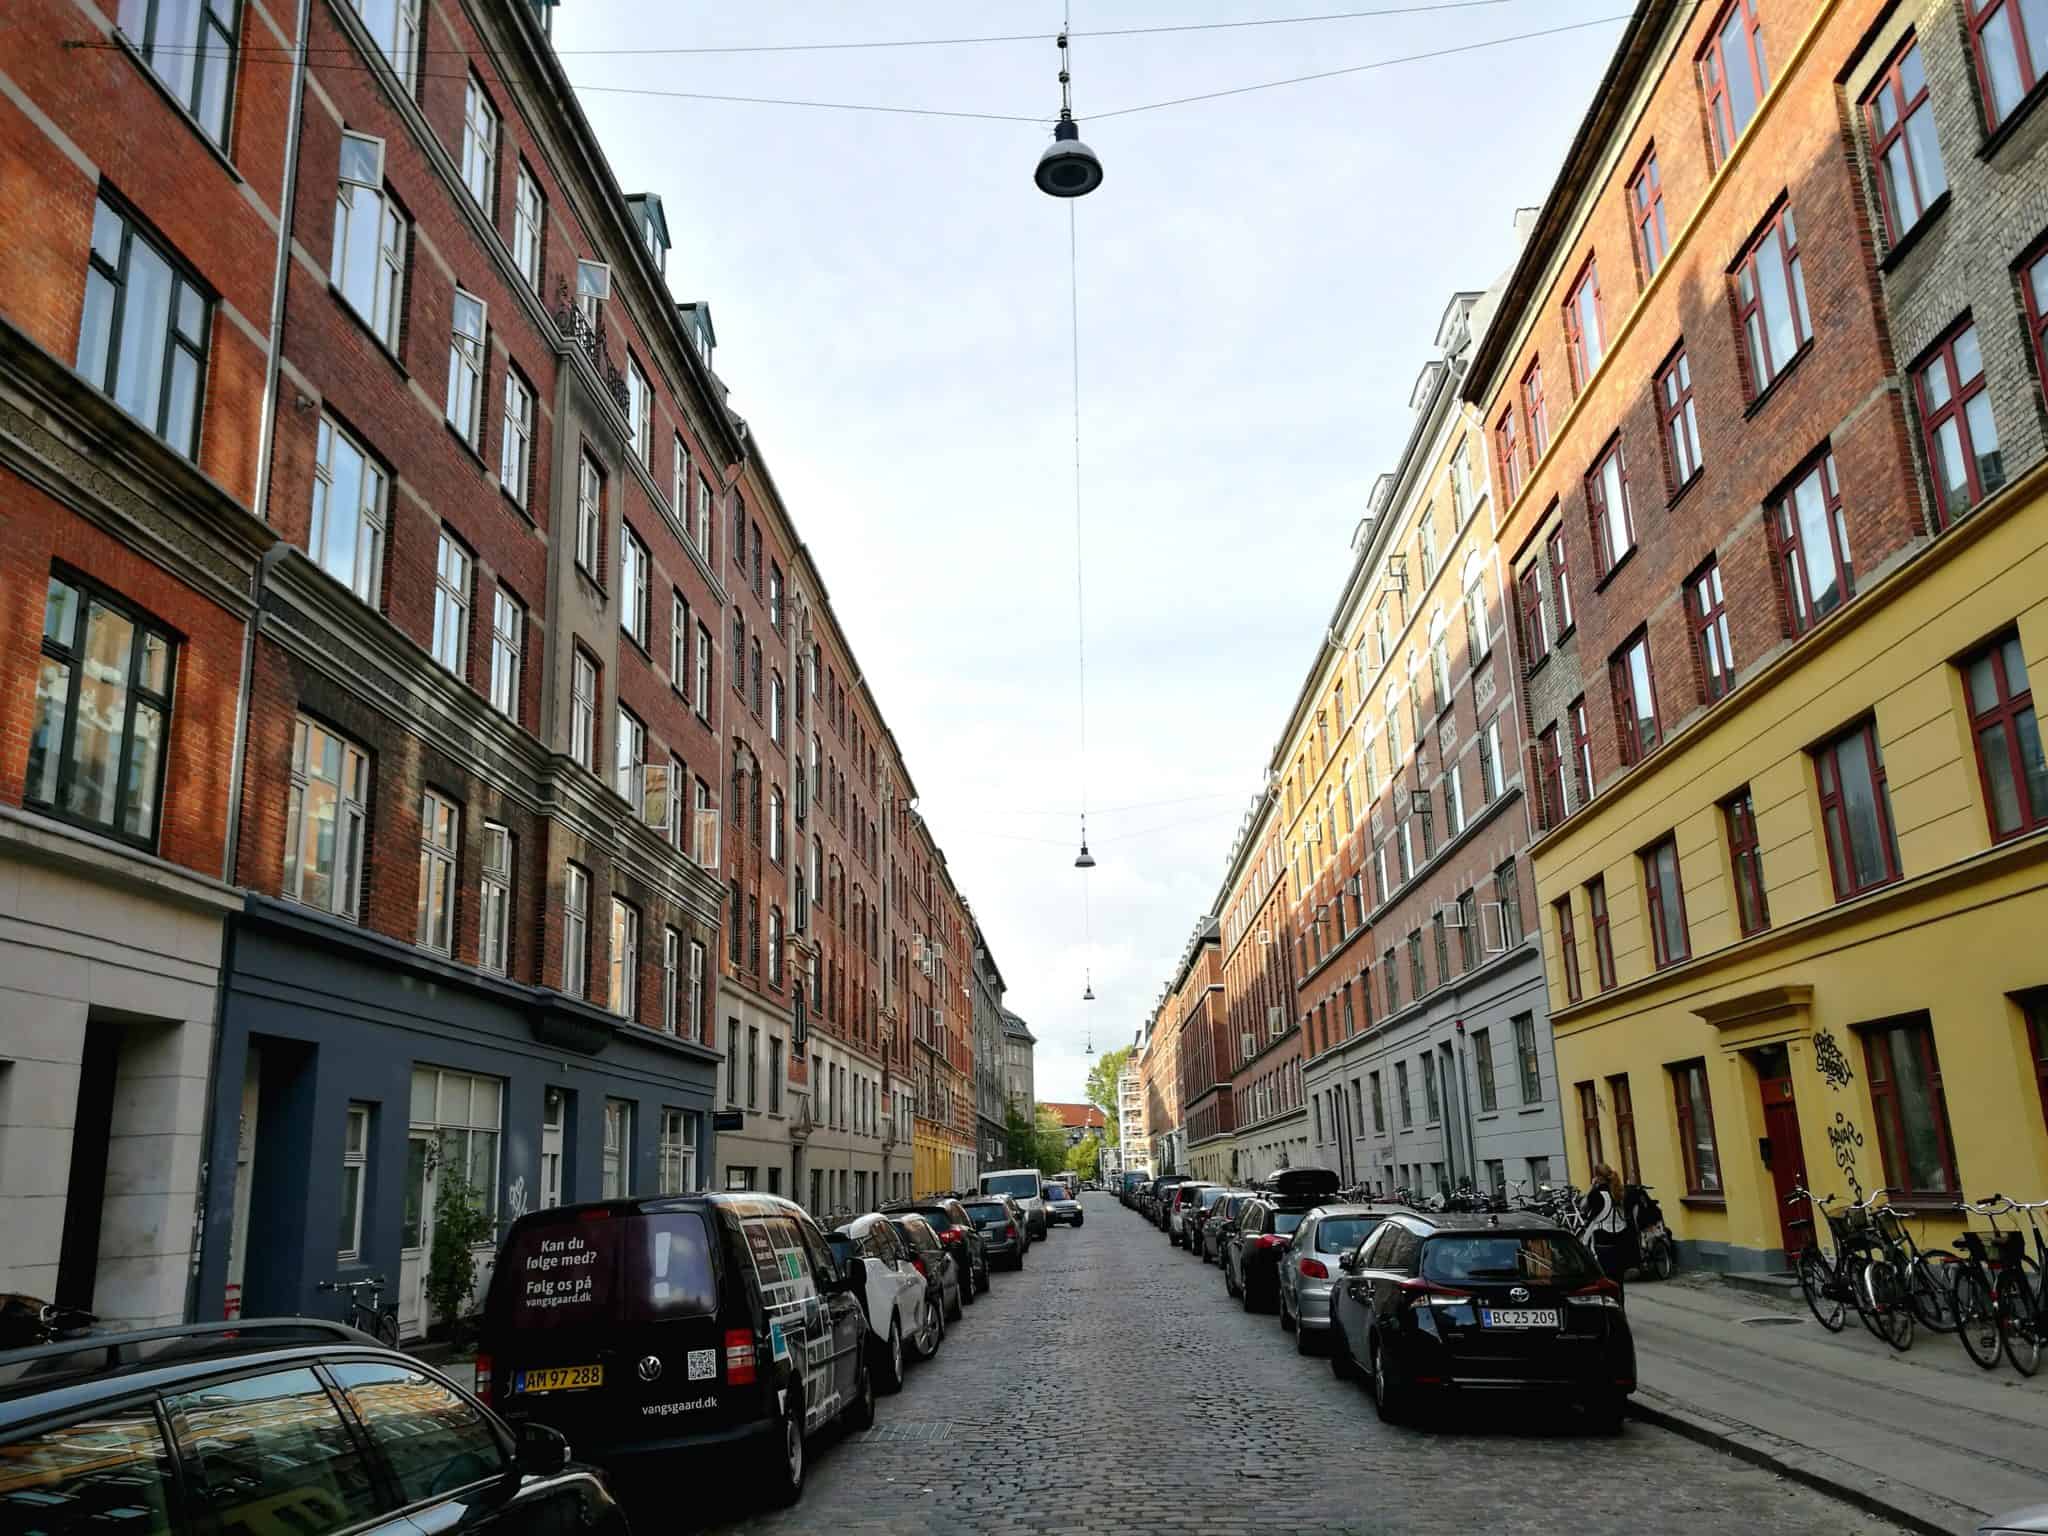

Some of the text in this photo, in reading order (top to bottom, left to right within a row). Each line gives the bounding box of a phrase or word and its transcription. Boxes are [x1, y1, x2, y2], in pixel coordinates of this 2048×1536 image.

[541, 1236, 584, 1253] Kan du
[526, 1251, 597, 1271] følge med?
[526, 1275, 592, 1295] Følg os på
[526, 1292, 592, 1308] vangsgaard.dk
[1492, 1311, 1555, 1324] BC 25 209
[526, 1366, 600, 1388] AM 97 288
[642, 1396, 718, 1415] vangsgaard.dk
